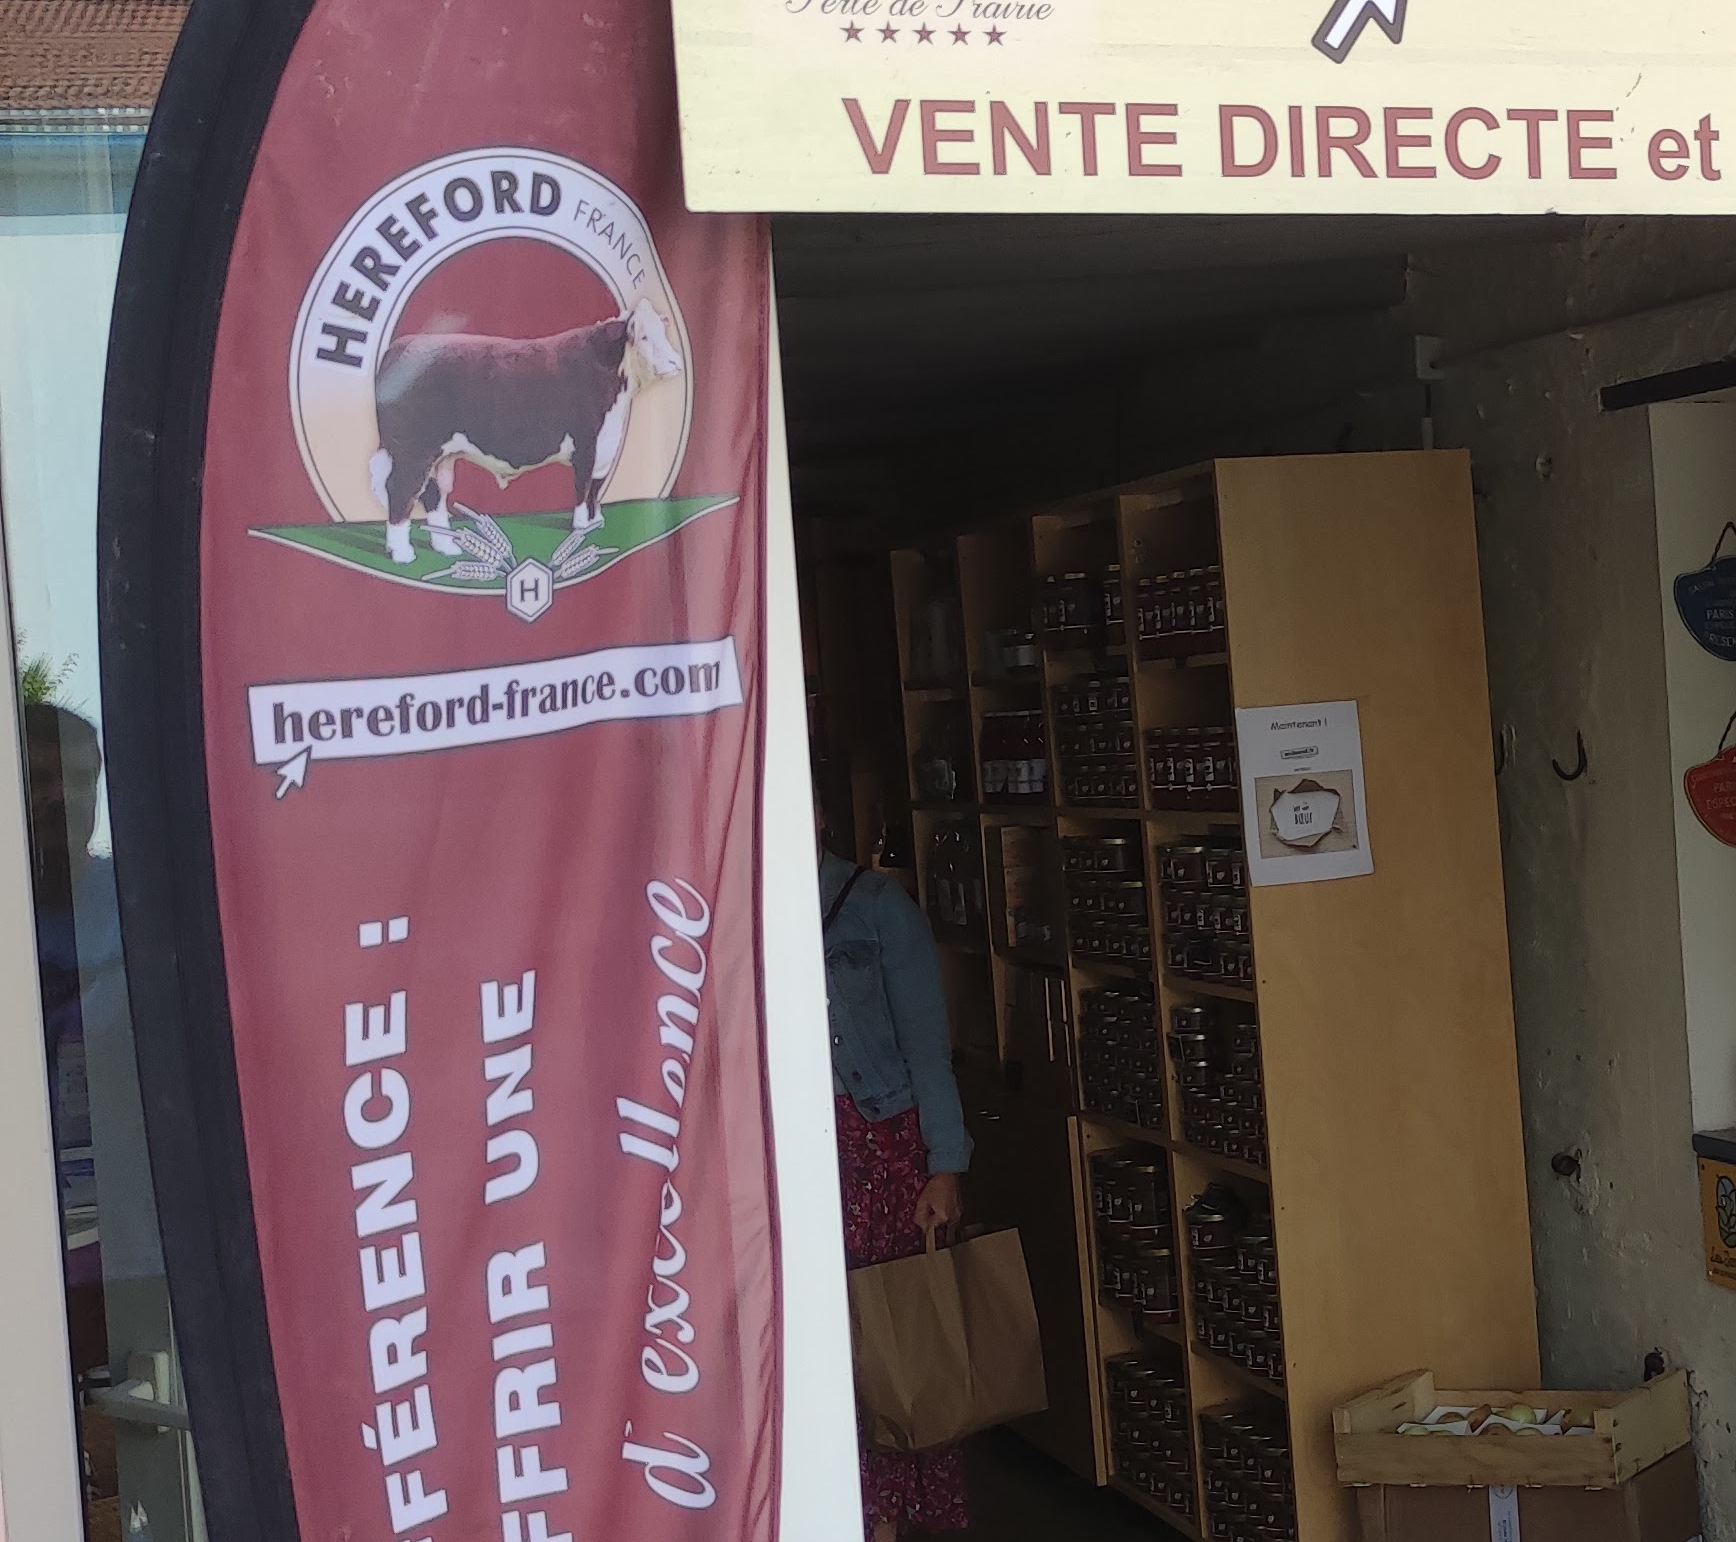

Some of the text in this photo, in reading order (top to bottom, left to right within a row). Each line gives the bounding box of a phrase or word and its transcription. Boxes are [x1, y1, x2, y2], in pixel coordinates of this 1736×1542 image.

[841, 97, 1184, 178] VENTE
[1218, 104, 1619, 181] DIRECTE
[1646, 114, 1722, 181] et
[315, 170, 648, 369] HEREFORD FRANCE
[271, 657, 723, 747] hereford-france.com
[479, 969, 542, 1206] UNE
